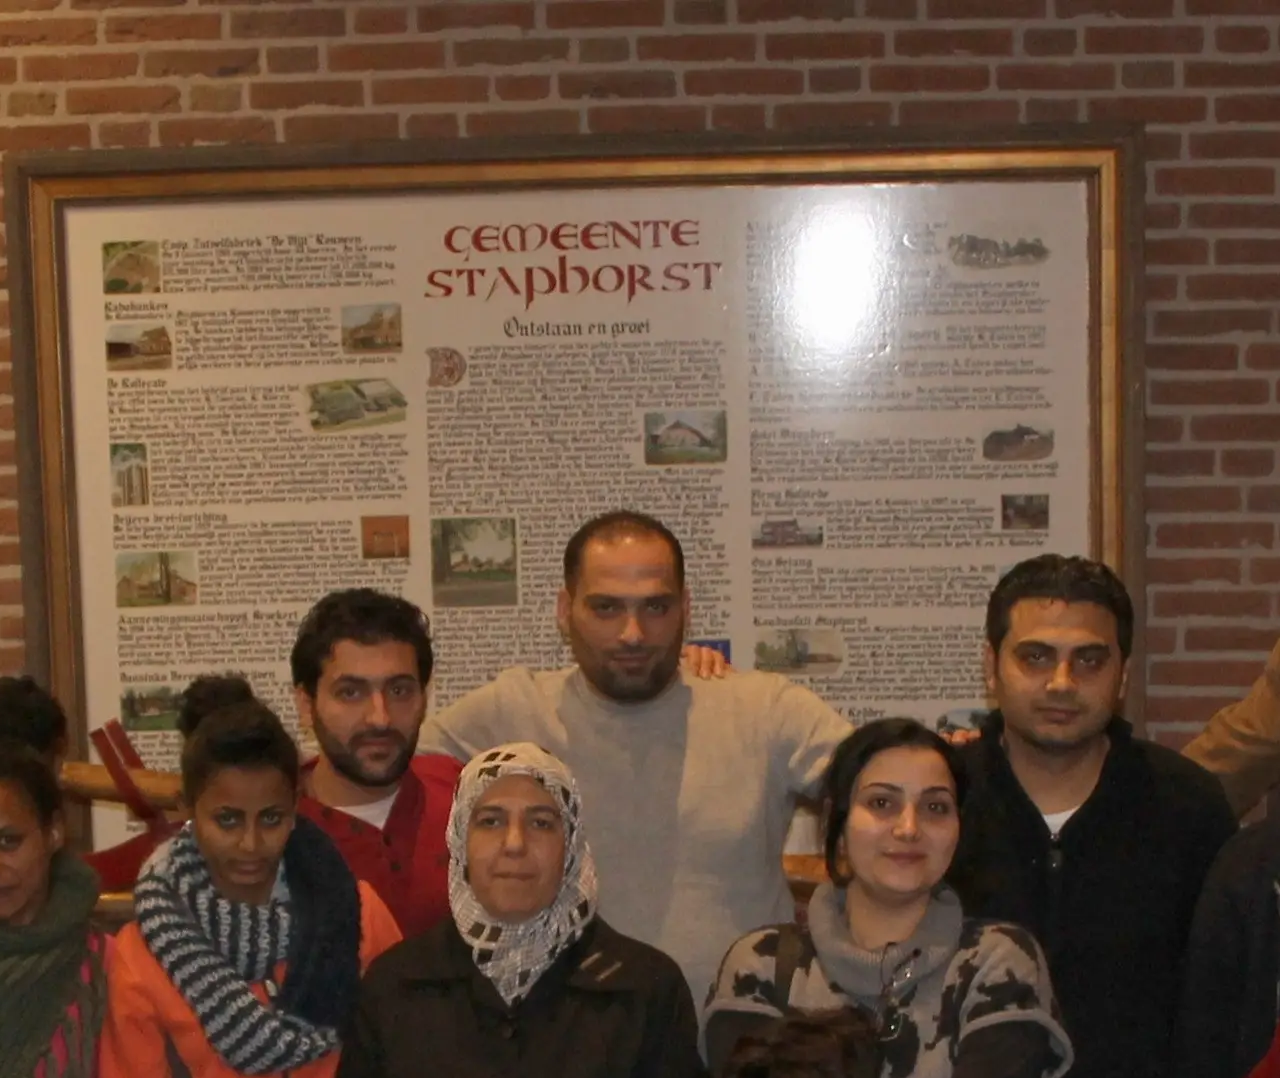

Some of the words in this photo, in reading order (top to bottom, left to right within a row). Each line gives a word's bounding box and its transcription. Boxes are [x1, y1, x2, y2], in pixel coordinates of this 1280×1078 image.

[443, 219, 701, 262] GEMEENTE
[503, 315, 583, 338] Ontstaan
[588, 323, 607, 335] en
[611, 318, 651, 338] groei
